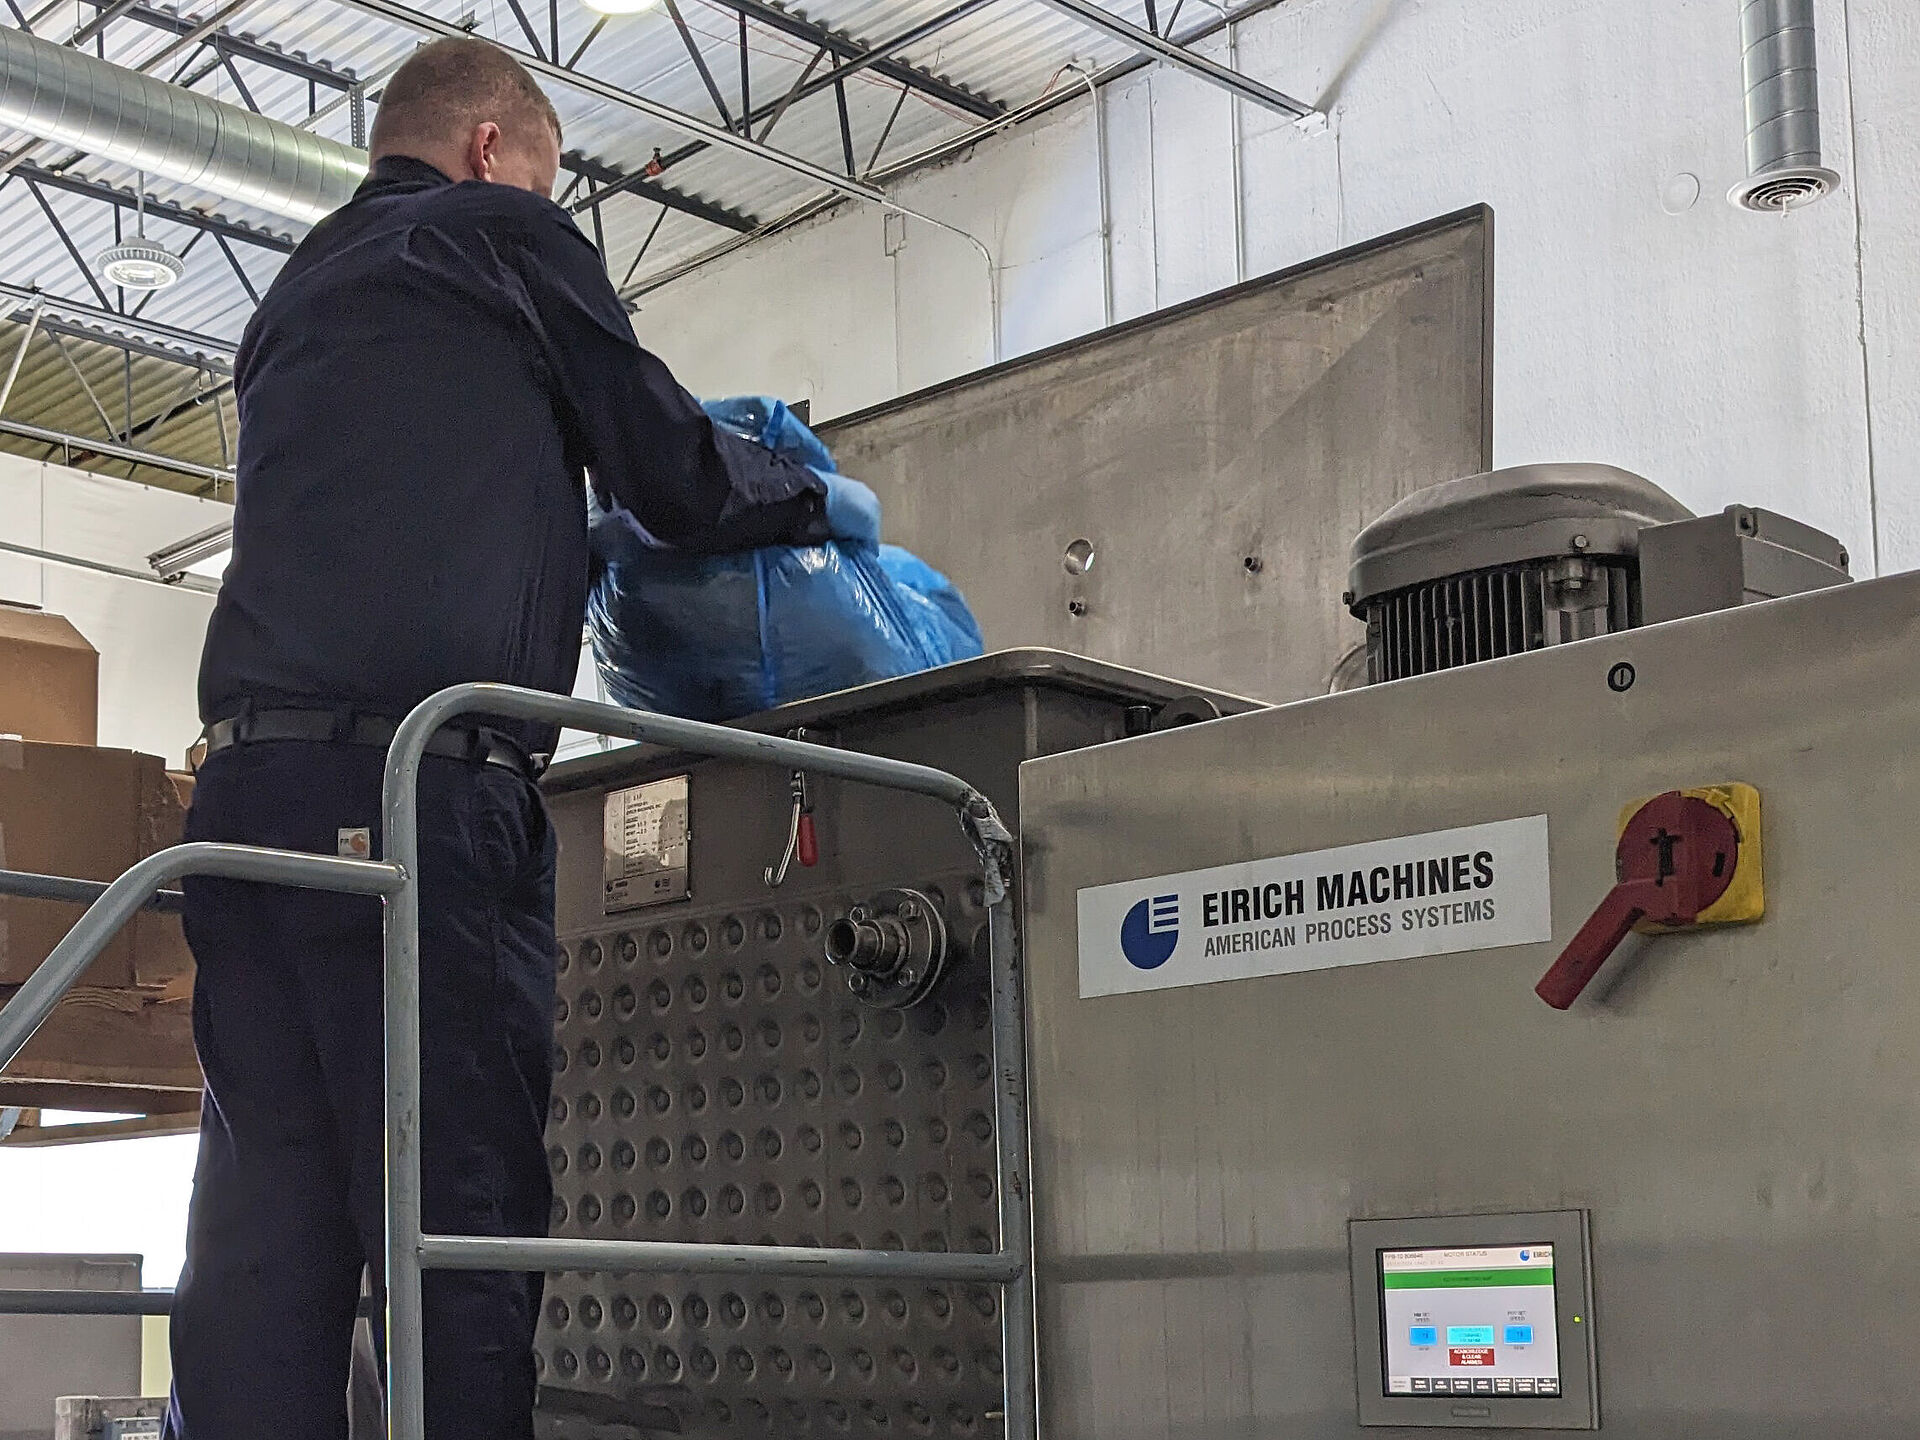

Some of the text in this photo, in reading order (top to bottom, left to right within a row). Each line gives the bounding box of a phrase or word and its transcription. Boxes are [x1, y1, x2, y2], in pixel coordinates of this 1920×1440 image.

[1202, 850, 1494, 928] EIRICH MACHINES
[1204, 898, 1495, 958] AMERICAN PROCESS SYSTEMS
